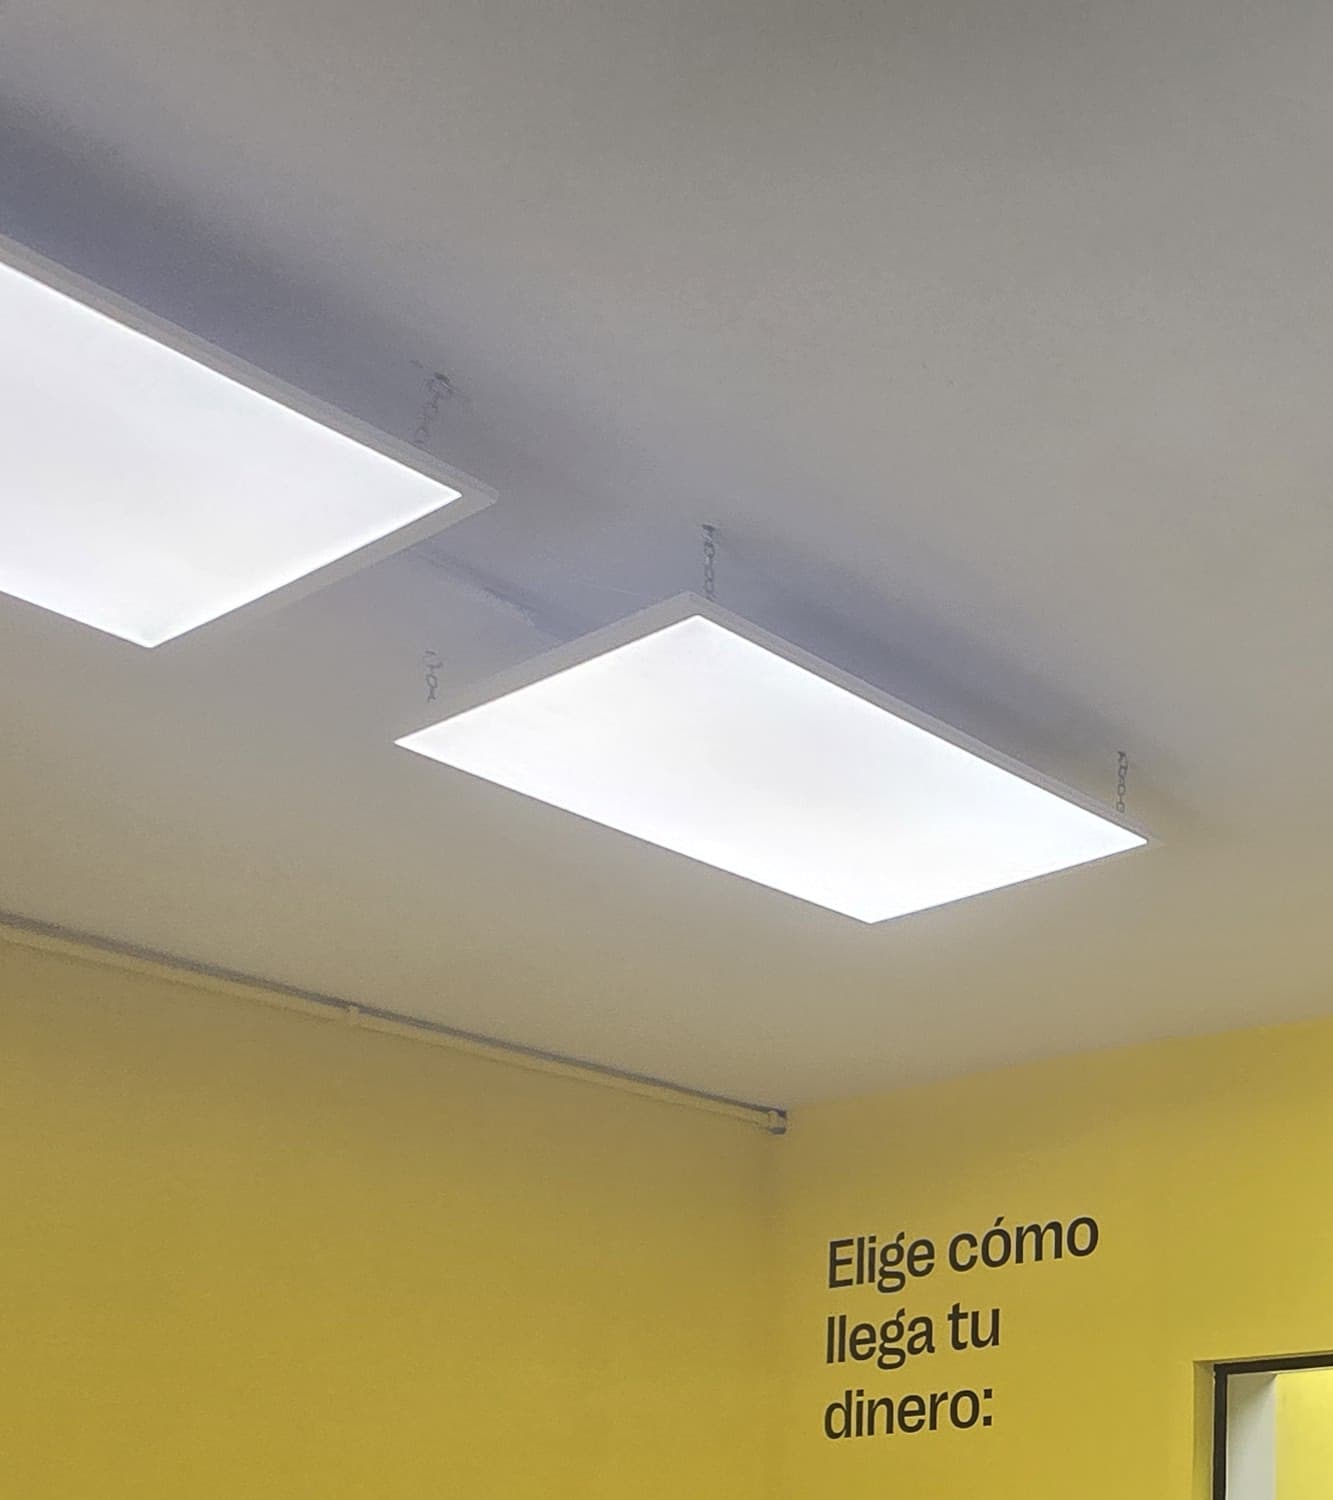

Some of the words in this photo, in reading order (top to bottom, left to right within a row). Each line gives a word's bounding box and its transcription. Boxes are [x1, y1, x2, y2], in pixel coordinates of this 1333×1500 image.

[828, 1231, 935, 1293] Elige
[948, 1216, 1099, 1272] cómo
[826, 1308, 935, 1370] llega
[947, 1303, 1000, 1351] tu
[824, 1388, 993, 1440] dinero:
